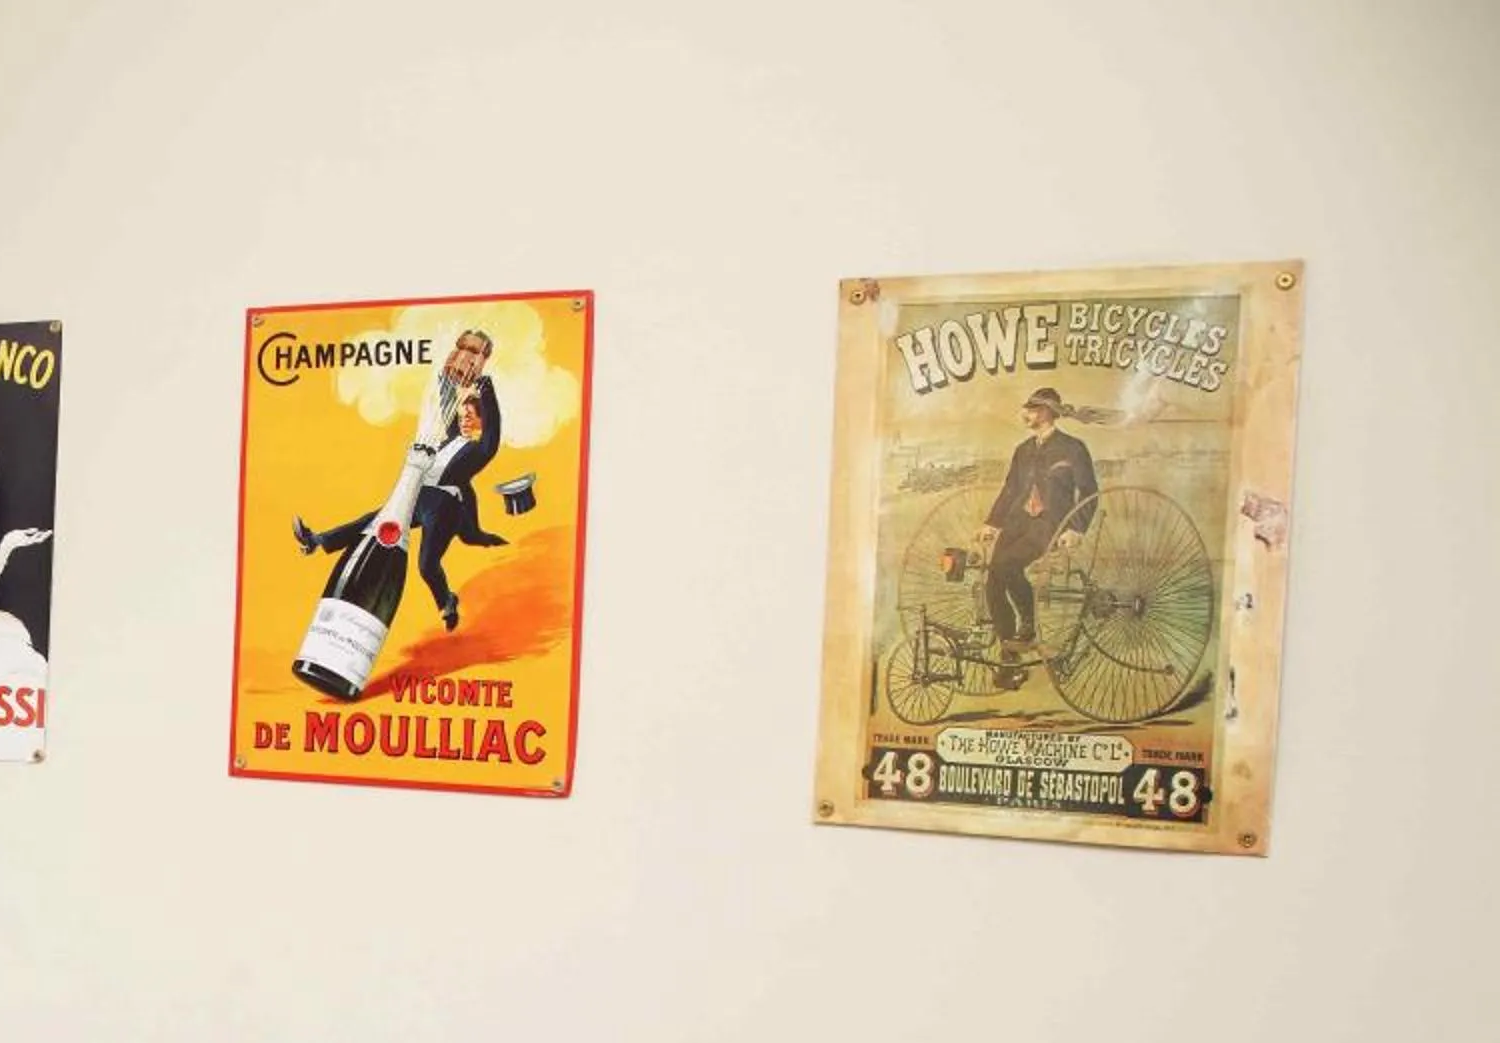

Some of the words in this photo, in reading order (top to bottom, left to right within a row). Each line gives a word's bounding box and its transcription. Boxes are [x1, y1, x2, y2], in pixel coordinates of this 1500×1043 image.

[257, 332, 433, 386] CHAMPAGNE
[898, 304, 1059, 394] HOWE
[1068, 302, 1227, 357] BICYCLES
[1065, 333, 1229, 392] TRICYCLES
[387, 673, 513, 708] VICOMTE
[254, 721, 291, 750] DE
[304, 712, 547, 765] MOULLIAC
[949, 735, 975, 755] THE
[977, 737, 1019, 756] HOWE
[1025, 740, 1088, 760] MACHINE
[873, 751, 934, 797] 48
[938, 765, 1013, 795] BOULEVARD
[1133, 767, 1200, 818] 48
